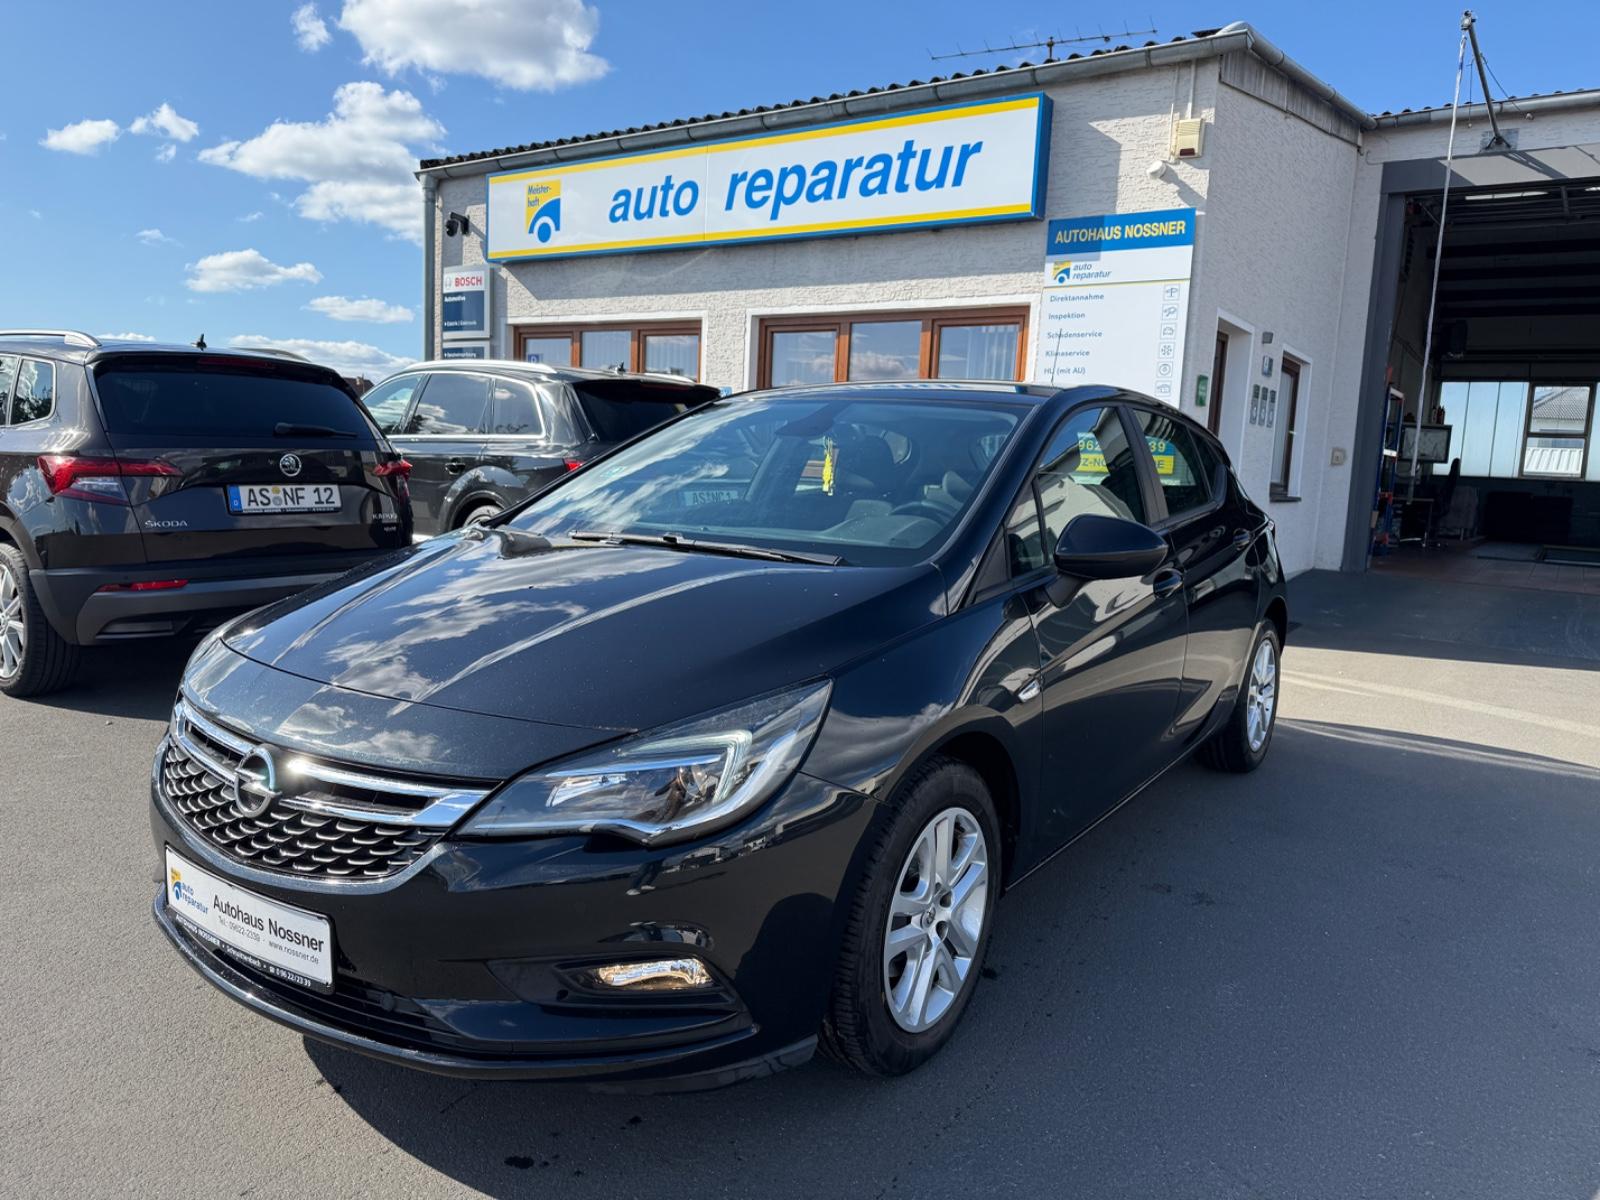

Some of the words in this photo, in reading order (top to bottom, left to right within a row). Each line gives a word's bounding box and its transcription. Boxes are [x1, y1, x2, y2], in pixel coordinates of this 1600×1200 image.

[608, 175, 700, 224] auto
[725, 139, 984, 221] reparatur
[527, 184, 552, 196] Meister-
[527, 197, 540, 208] haft
[1055, 225, 1122, 244] AUTOHAUS
[1124, 220, 1187, 239] NOSSNER
[1073, 263, 1093, 271] auto
[1072, 270, 1112, 281] reparatur
[454, 276, 483, 288] BOSCH
[1049, 293, 1105, 303] Direktannahme
[1048, 312, 1086, 321] Inspektion
[1056, 367, 1071, 376] (mit
[1072, 366, 1086, 375] AU)
[247, 487, 272, 507] AS
[284, 486, 305, 505] NF
[313, 486, 336, 505] 12
[182, 882, 194, 896] auto
[182, 892, 208, 914] reparatur
[213, 894, 264, 931] Autohaus
[268, 918, 324, 953] Nossner
[268, 940, 319, 964] www.nossner.de
